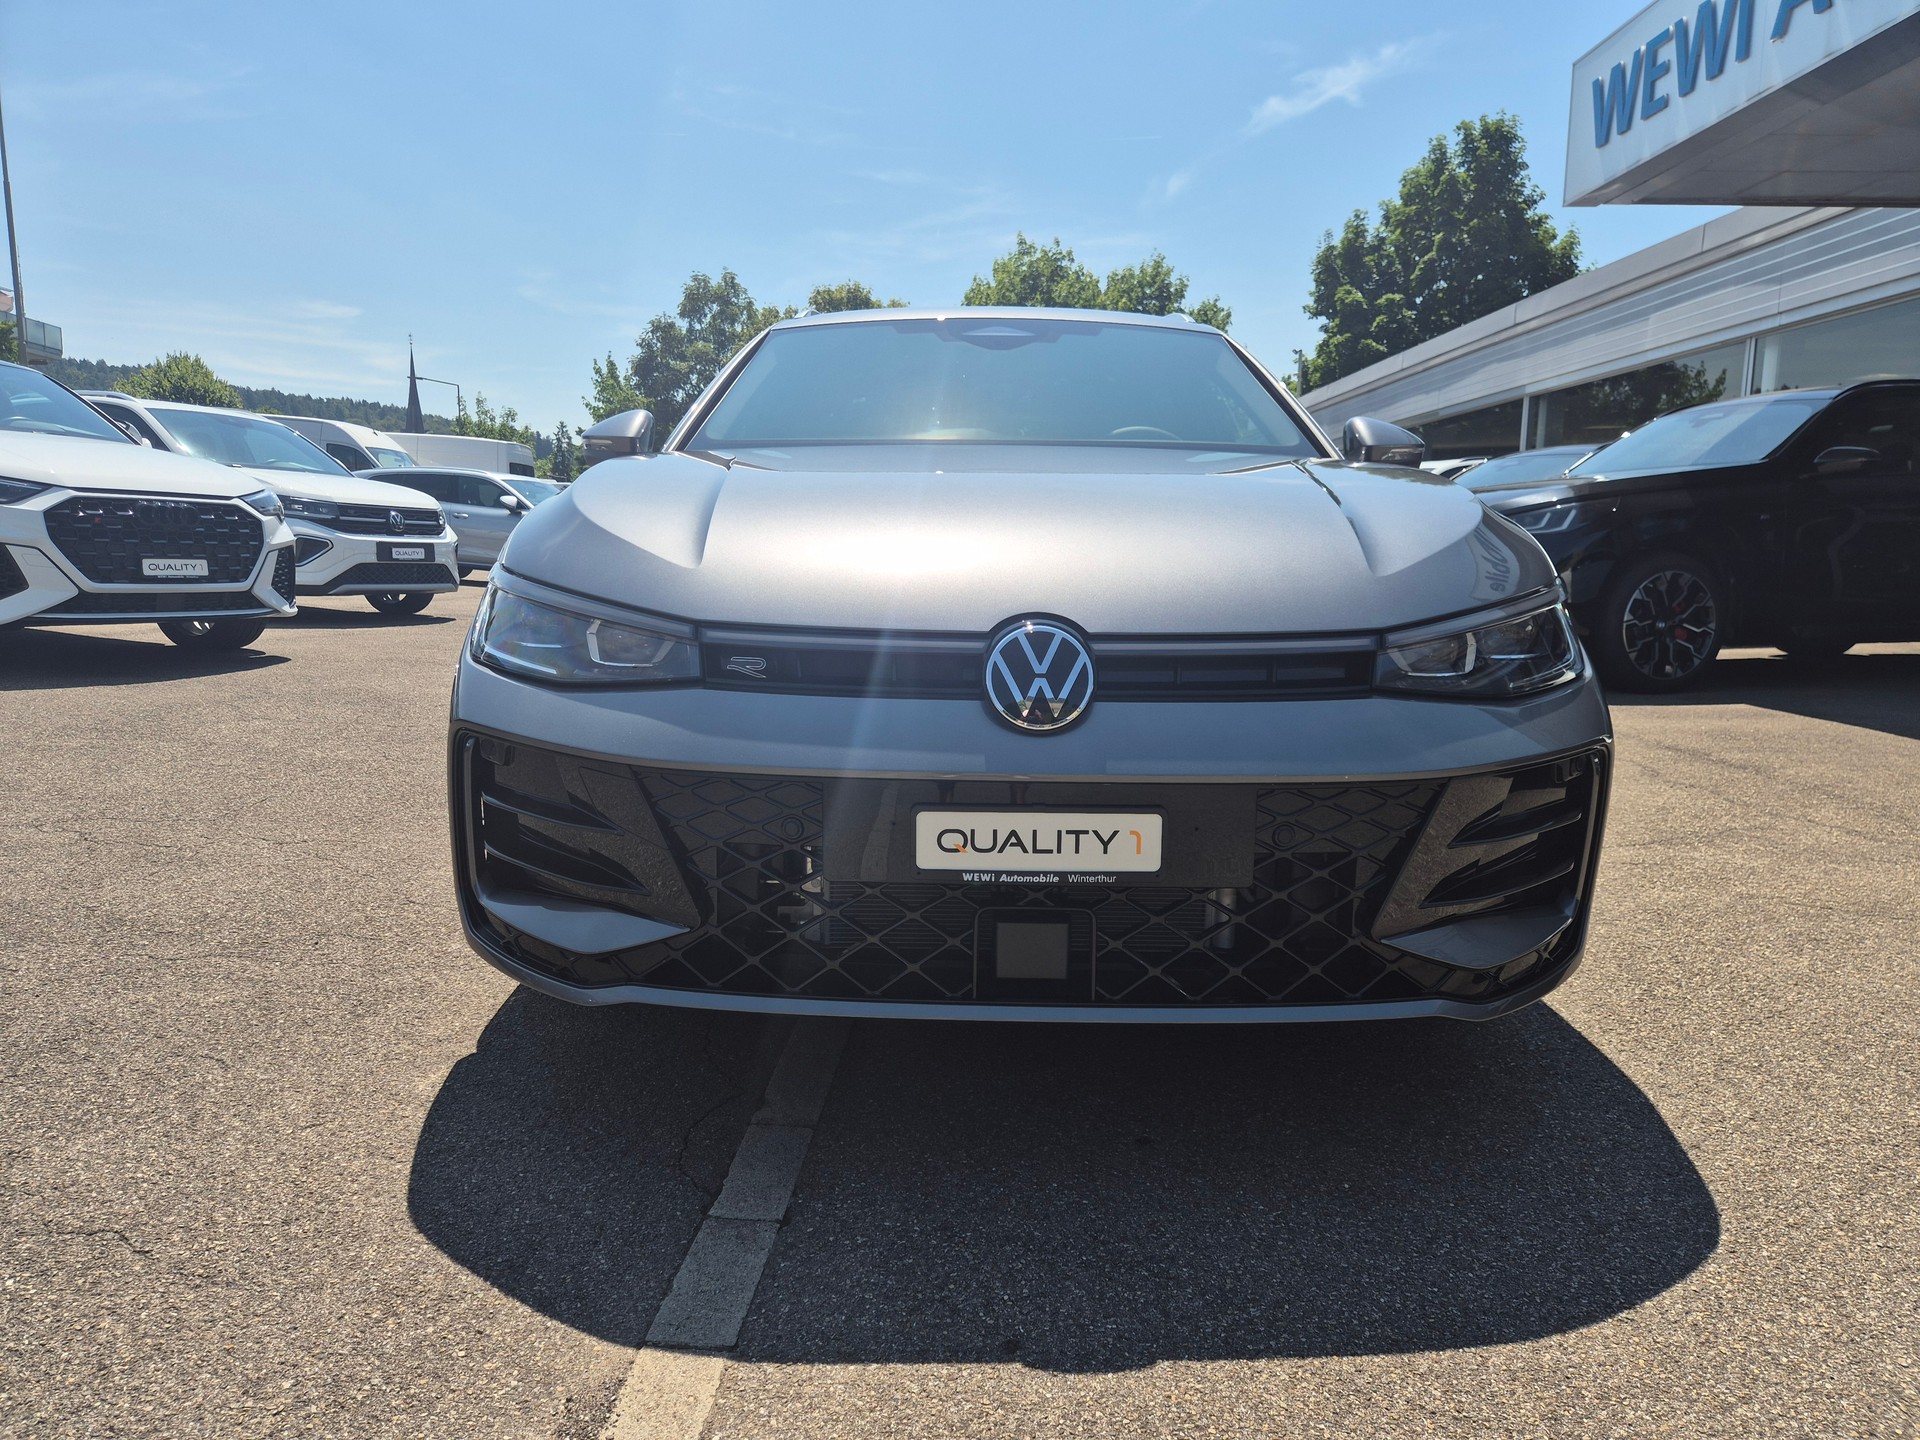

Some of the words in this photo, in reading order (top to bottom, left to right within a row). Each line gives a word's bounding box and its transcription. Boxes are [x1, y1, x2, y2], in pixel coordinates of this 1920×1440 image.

[148, 563, 197, 571] QUALITY
[936, 828, 1120, 854] QUALITY
[1129, 830, 1142, 854] 1
[962, 872, 995, 882] WEWi
[999, 873, 1060, 883] Automobile
[1067, 874, 1117, 883] Winterthur
